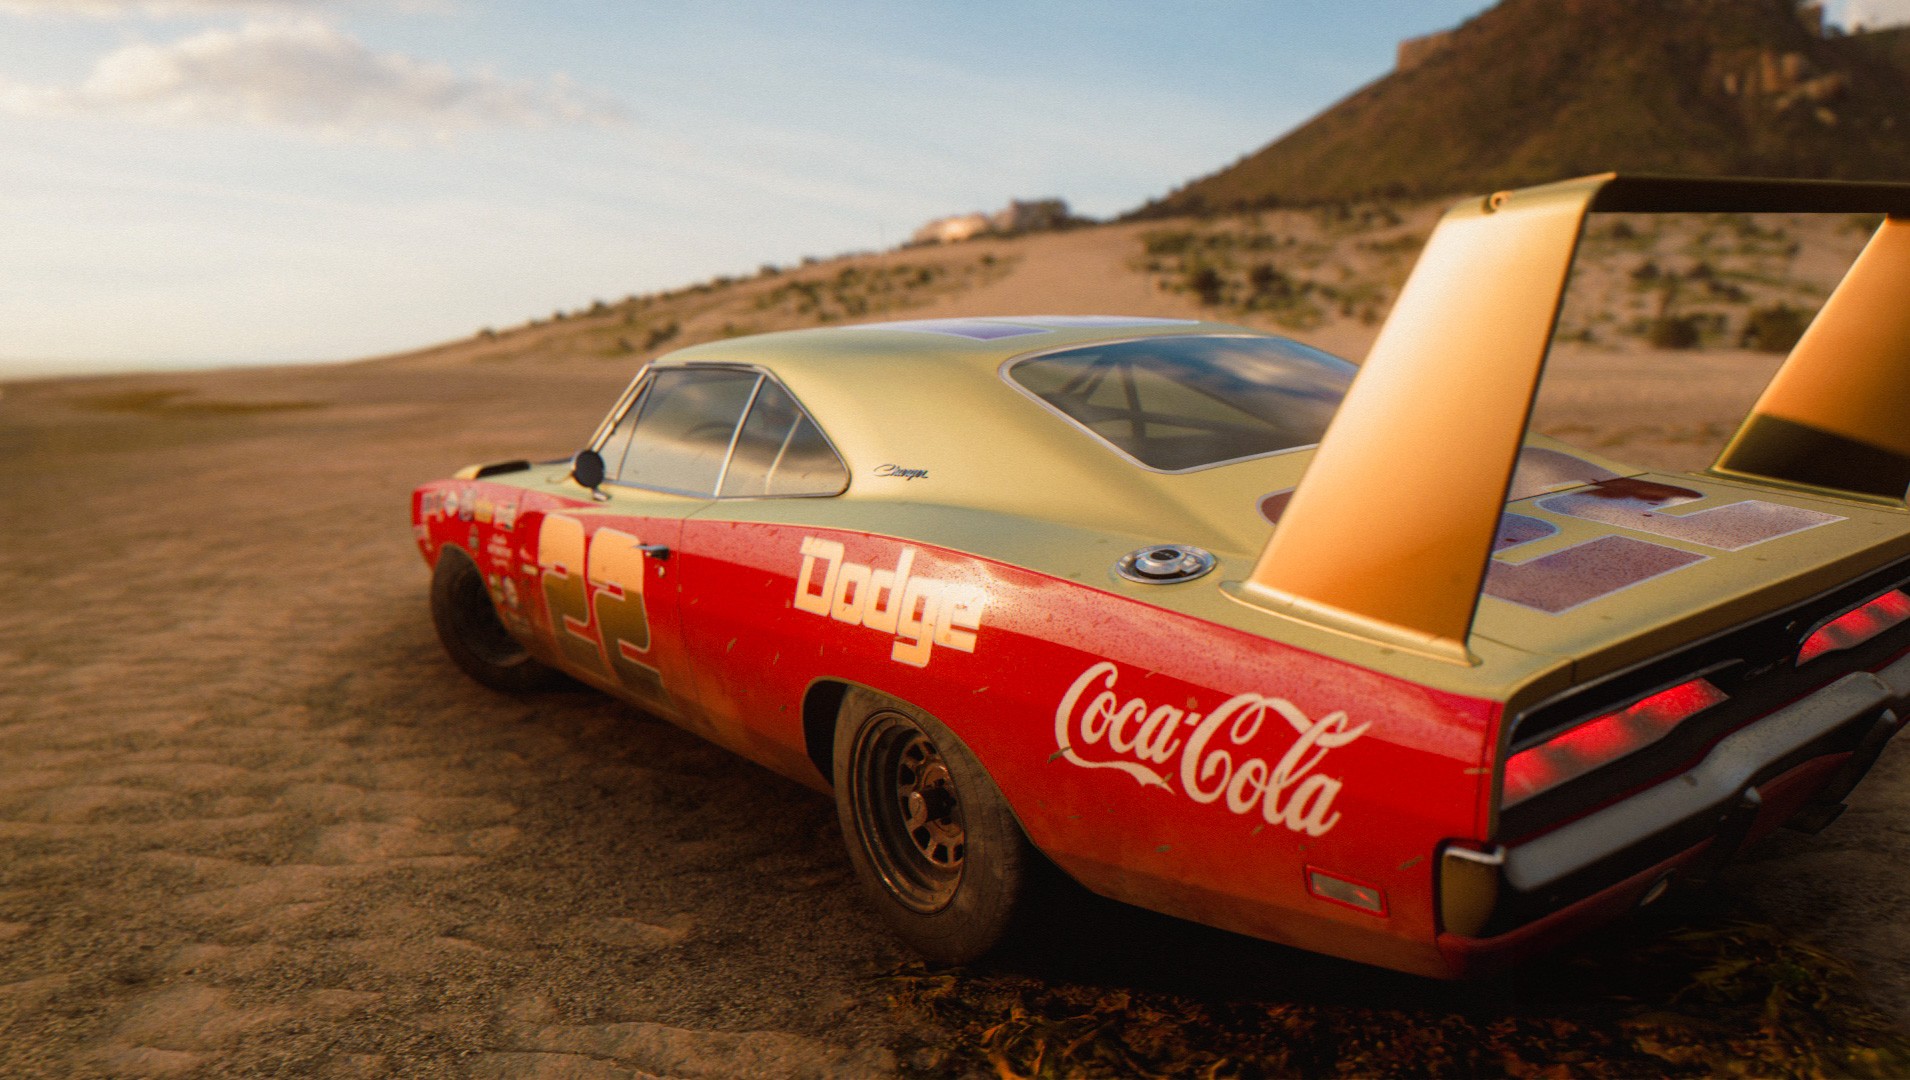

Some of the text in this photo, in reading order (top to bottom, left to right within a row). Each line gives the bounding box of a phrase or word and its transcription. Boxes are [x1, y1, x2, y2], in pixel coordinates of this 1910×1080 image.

[539, 513, 670, 706] 22
[793, 536, 988, 667] Dodge
[1054, 661, 1372, 836] Coca-Cola
